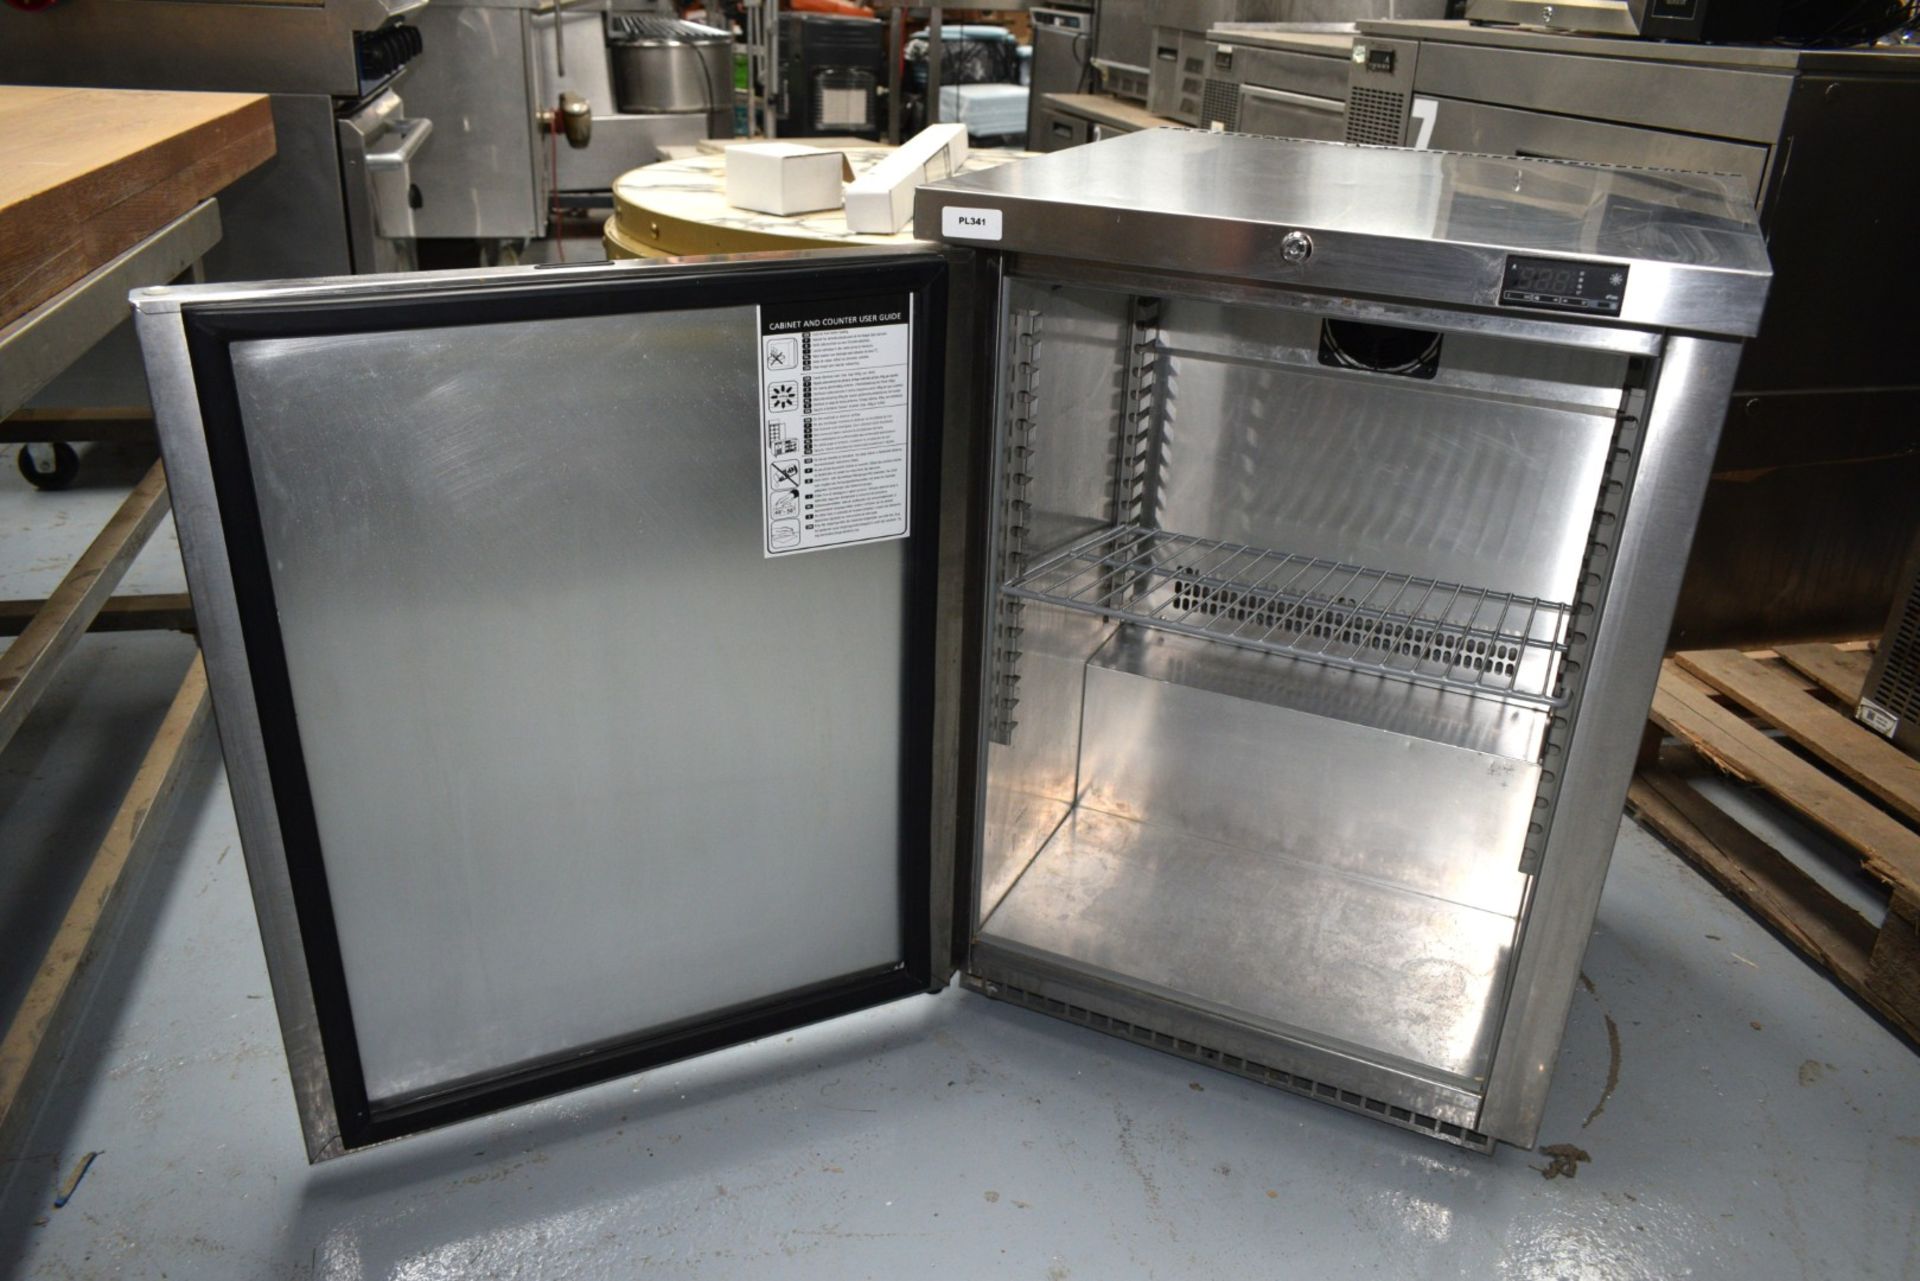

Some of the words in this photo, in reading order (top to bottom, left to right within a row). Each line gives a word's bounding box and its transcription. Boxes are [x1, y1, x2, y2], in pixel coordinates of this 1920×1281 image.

[958, 216, 986, 226] PL341
[769, 320, 802, 331] CABINET
[803, 318, 821, 328] AND
[822, 316, 857, 326] COUNTER
[859, 314, 878, 323] USER
[879, 312, 902, 321] GUIDE
